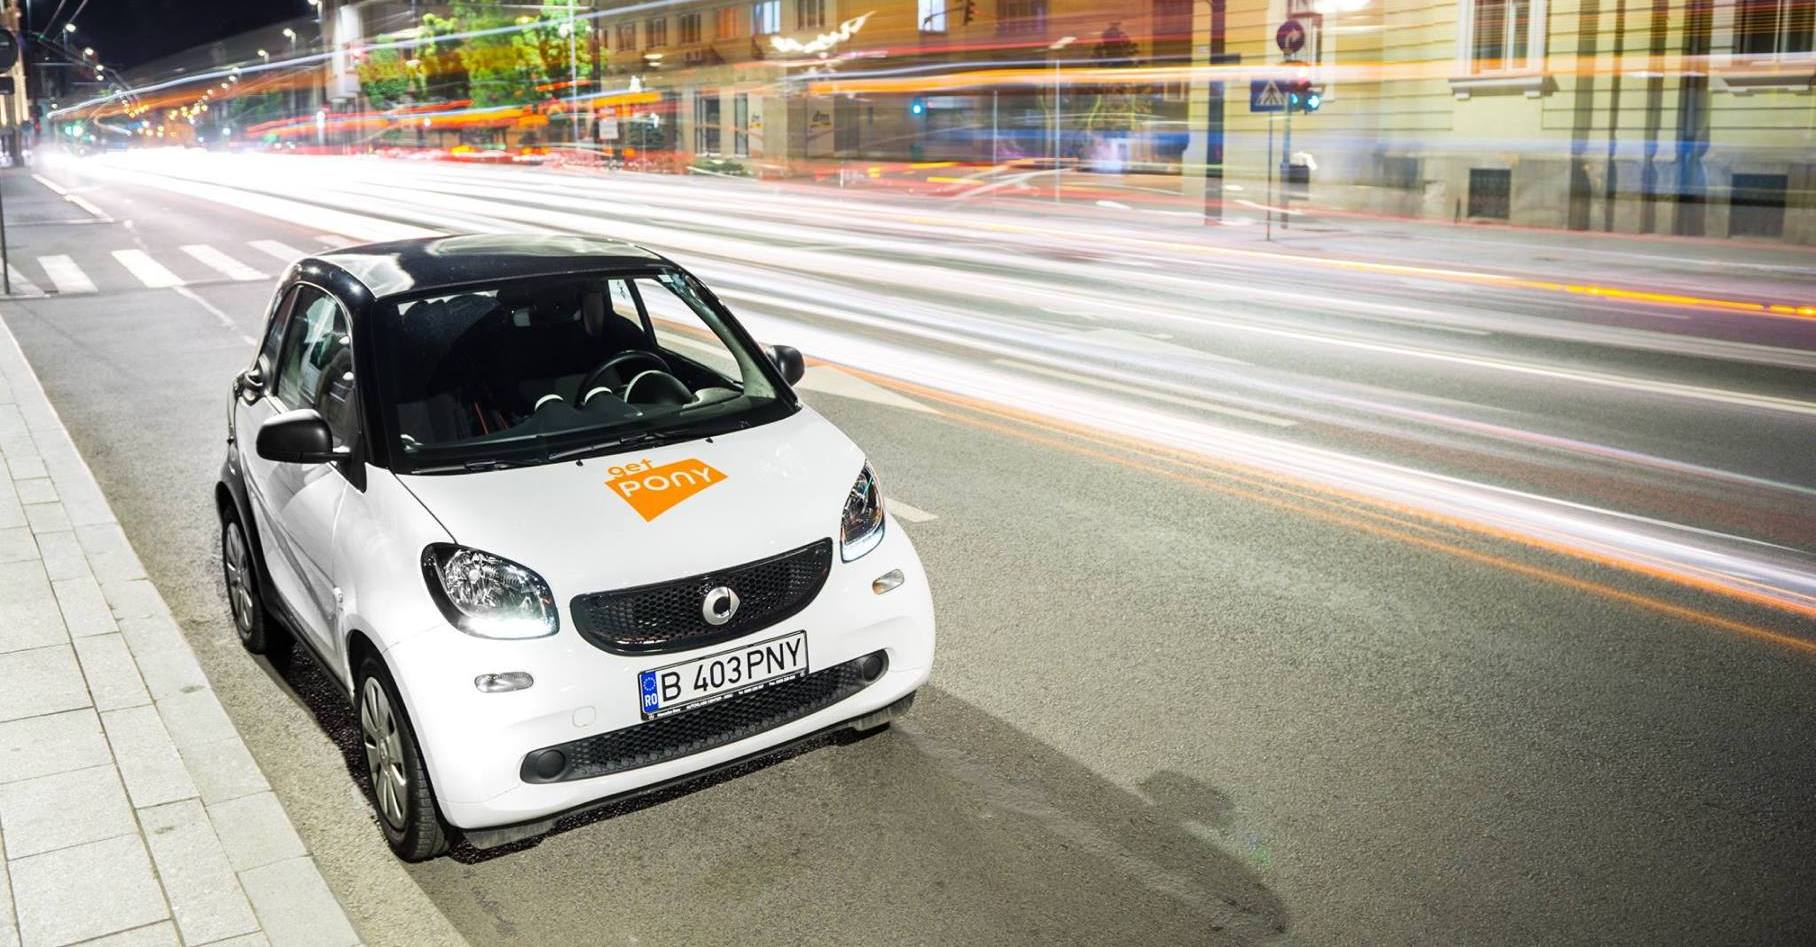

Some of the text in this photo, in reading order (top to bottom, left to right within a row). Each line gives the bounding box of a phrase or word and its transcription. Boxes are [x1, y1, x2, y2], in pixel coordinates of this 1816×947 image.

[607, 457, 652, 478] get
[661, 671, 682, 702] B
[645, 693, 658, 707] RO
